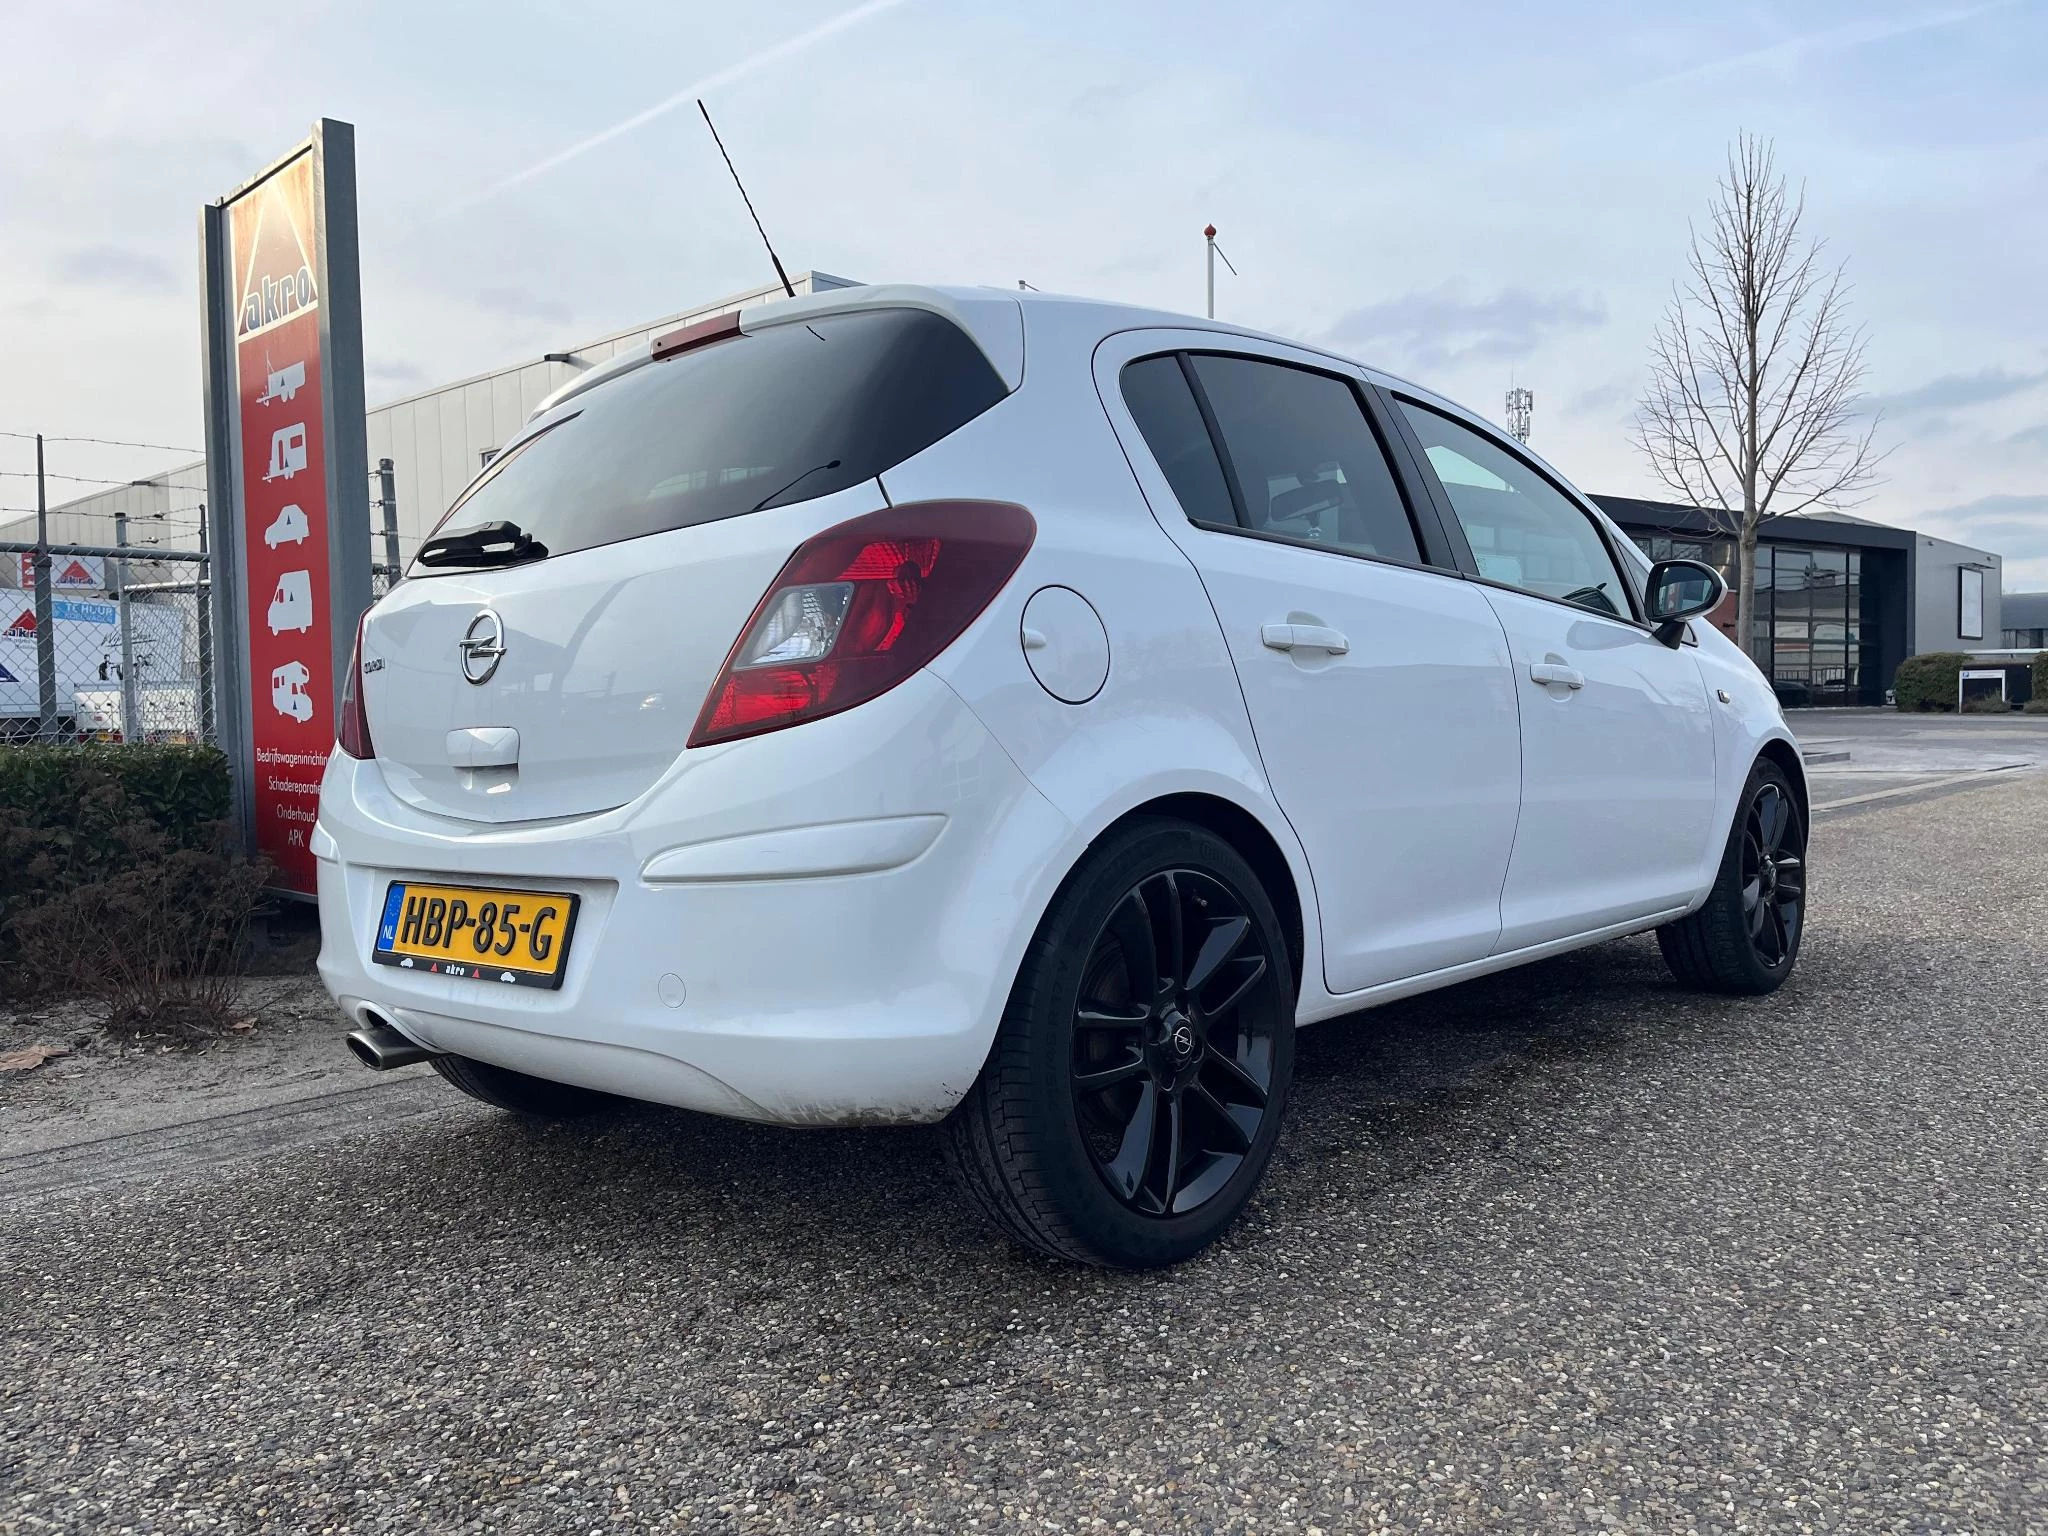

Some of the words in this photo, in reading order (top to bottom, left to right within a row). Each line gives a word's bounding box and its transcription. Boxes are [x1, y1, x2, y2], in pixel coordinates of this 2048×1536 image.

[246, 266, 310, 331] akro
[9, 626, 38, 638] akr
[256, 747, 328, 767] Bedrijfswageninrichtin
[268, 775, 321, 795] Schadereparatie
[276, 803, 315, 823] Onderhoud
[288, 829, 304, 847] APK
[383, 925, 393, 939] NL
[400, 895, 557, 962] HBP-85-G
[445, 964, 465, 976] akro
